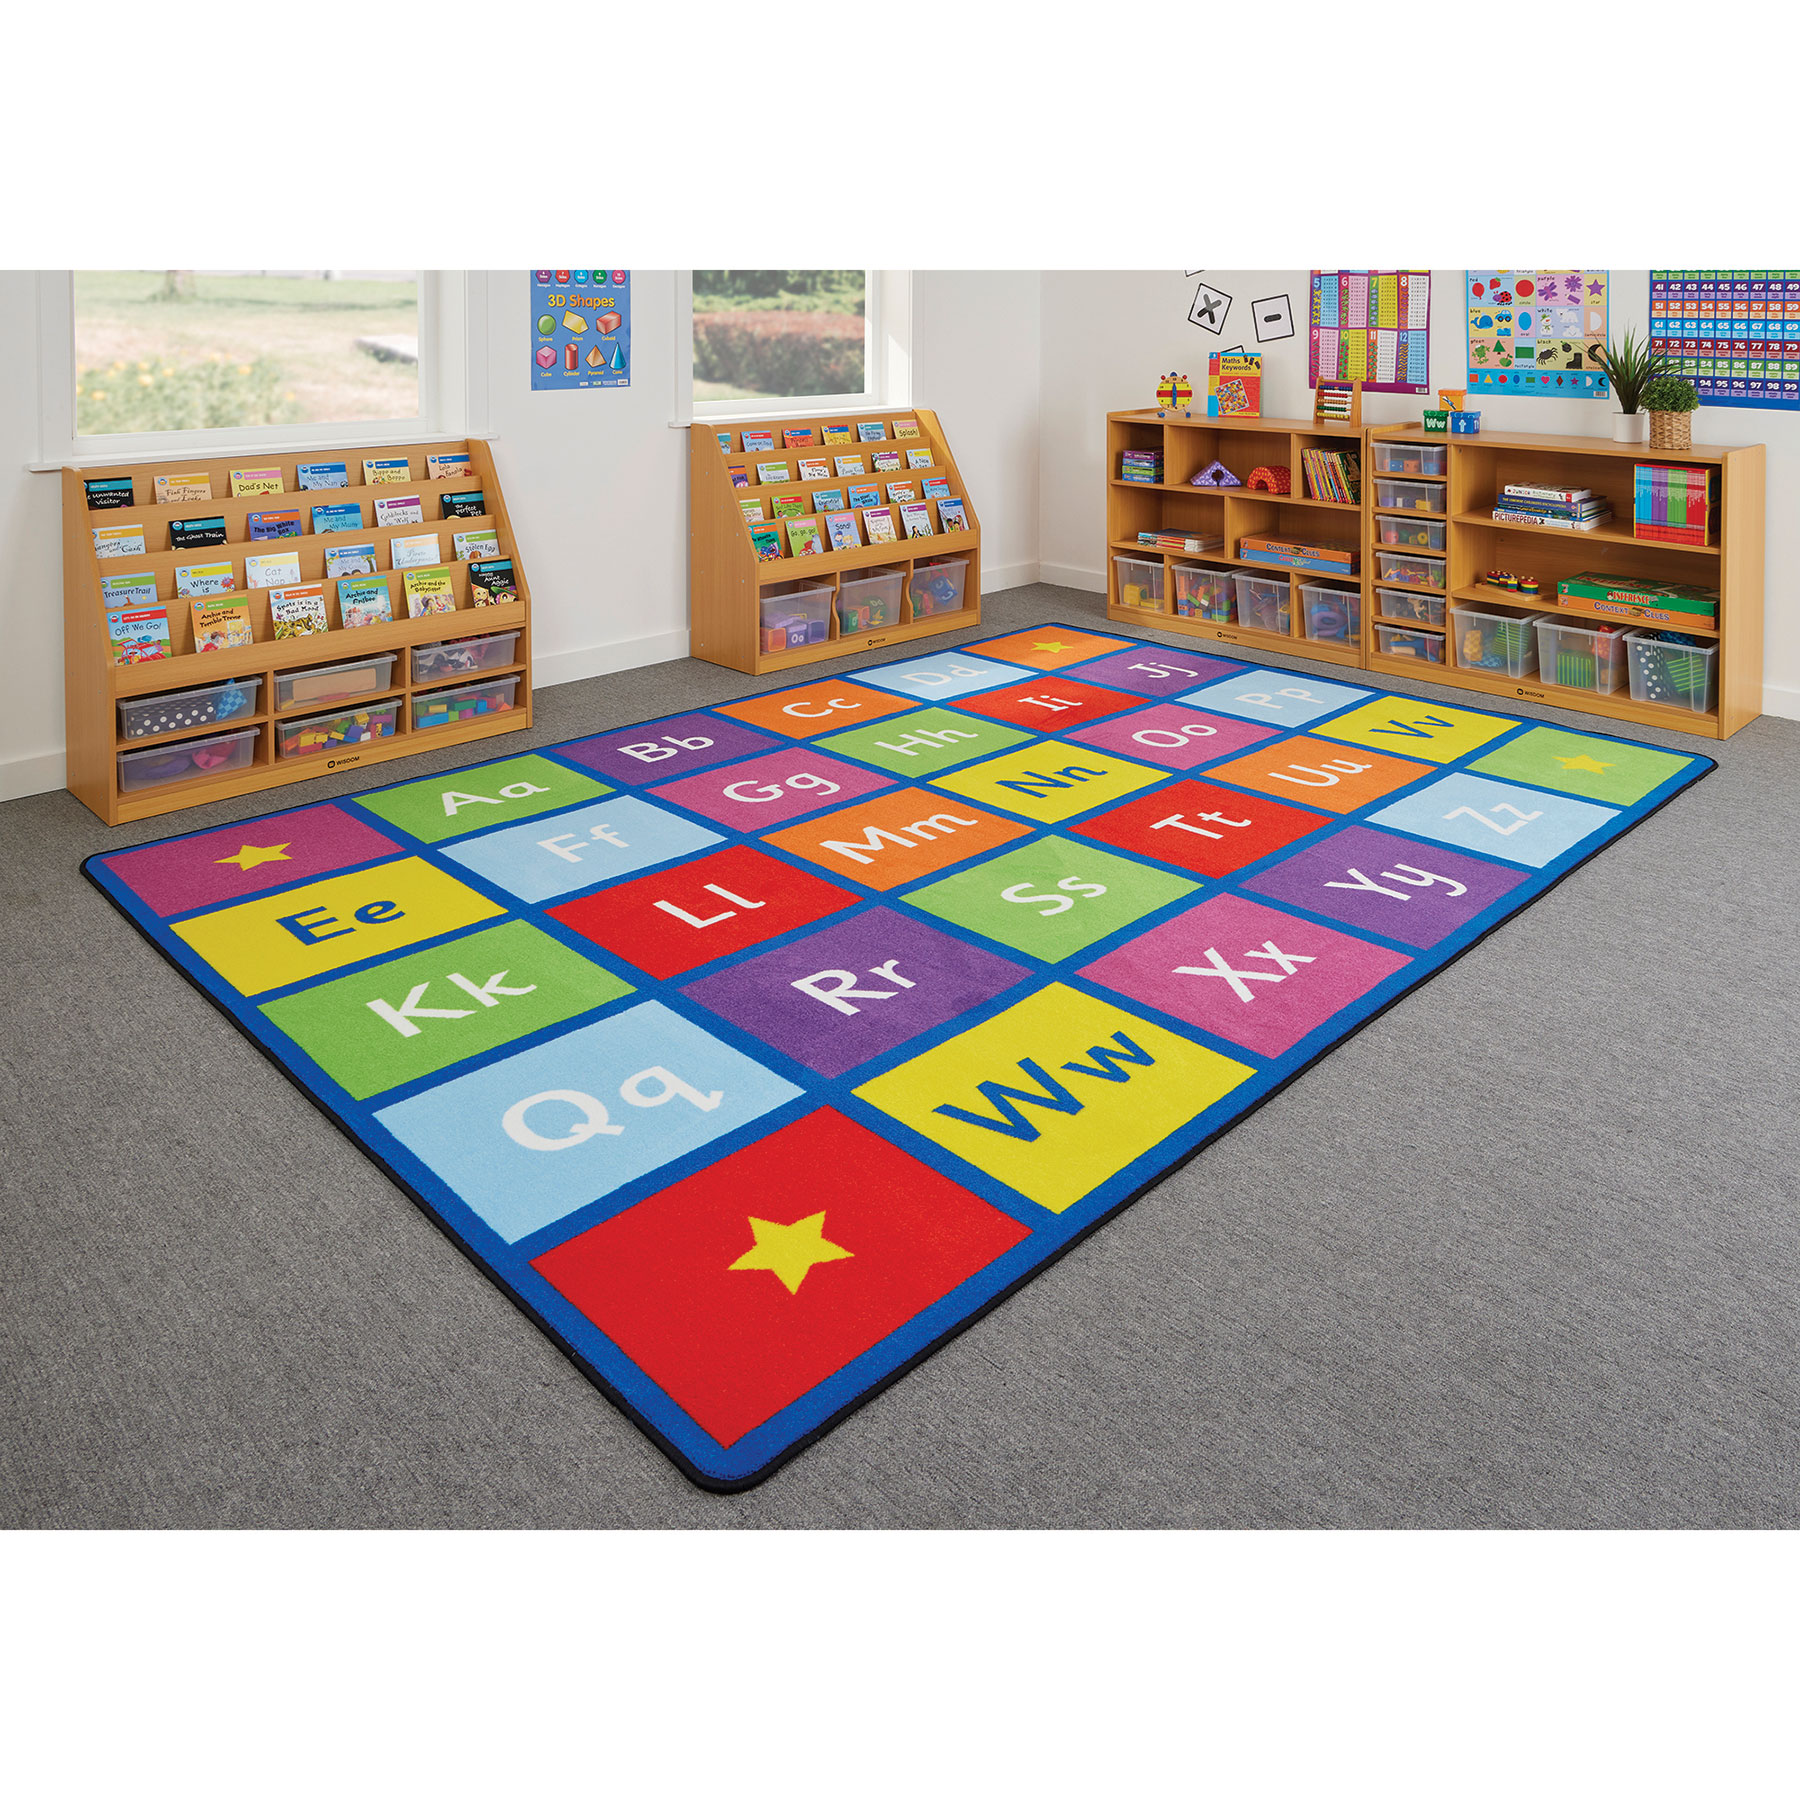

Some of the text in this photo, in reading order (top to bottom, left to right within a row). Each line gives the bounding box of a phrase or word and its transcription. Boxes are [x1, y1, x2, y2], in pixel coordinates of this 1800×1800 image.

[1313, 277, 1320, 288] 5
[1341, 276, 1348, 287] 6
[1371, 277, 1378, 288] 7
[1400, 276, 1408, 287] 8
[1655, 283, 1664, 291] 41
[1669, 283, 1681, 291] 42
[1685, 283, 1697, 291] 43
[1701, 283, 1714, 291] 44
[1718, 283, 1730, 291] 45
[1734, 283, 1748, 291] 46
[1752, 283, 1764, 291] 47
[1769, 283, 1782, 291] 48
[1786, 283, 1800, 291] 49
[548, 294, 615, 311] 3D Shapes
[1655, 302, 1664, 310] 51
[1669, 302, 1681, 310] 52
[1685, 302, 1697, 310] 53
[1701, 302, 1713, 310] 54
[1769, 303, 1781, 311] 58
[1786, 303, 1799, 311] 59
[1734, 322, 1746, 330] 66
[1312, 329, 1319, 340] 9
[1370, 330, 1377, 340] 11
[1400, 331, 1408, 342] 12
[1701, 341, 1712, 349] 74
[1751, 342, 1762, 350] 77
[1786, 343, 1797, 351] 79
[1733, 361, 1746, 369] 86
[1767, 362, 1780, 370] 88
[1716, 380, 1728, 388] 95
[1425, 418, 1445, 428] Ww
[899, 428, 918, 437] Splash!
[238, 482, 278, 491] Dad's Net
[92, 491, 130, 499] Unwanted
[95, 497, 120, 505] Visitor
[1494, 512, 1538, 525] PICTUREPEDIA
[276, 521, 295, 530] White
[205, 531, 224, 539] Train
[265, 567, 282, 577] Cat
[190, 579, 219, 588] Where
[104, 587, 151, 598] Treasure Trail
[345, 590, 366, 599] Archie
[1612, 591, 1650, 605] INFERENCE
[276, 600, 296, 611] Spots
[115, 621, 162, 636] Off We Go!
[791, 633, 804, 643] Oo
[900, 664, 989, 686] Dd
[1126, 662, 1199, 679] Jj
[1233, 687, 1325, 709] Pp
[1524, 690, 1545, 698] WISDOM
[782, 698, 862, 718] Cc
[1017, 697, 1083, 712] Ii
[1369, 715, 1456, 739] Vv
[1132, 723, 1218, 748] Oo
[874, 728, 980, 756] Hh
[617, 735, 715, 764] Bb
[336, 756, 360, 765] WISDOM
[1268, 759, 1372, 787] Uu
[723, 772, 842, 803] Gg
[996, 766, 1108, 798] Nn
[442, 782, 551, 817] Aa
[1441, 802, 1545, 836] Zz
[1150, 811, 1252, 840] Tt
[536, 823, 630, 863] Ff
[820, 814, 978, 865] Mm
[1323, 863, 1468, 902] Yy
[1000, 875, 1108, 917] Ss
[653, 883, 766, 929] Ll
[275, 901, 405, 946] Ee
[1172, 940, 1317, 1004] Xx
[790, 958, 917, 1017] Rr
[366, 970, 537, 1038] Kk
[933, 1031, 1156, 1143] Ww
[501, 1065, 724, 1151] Qq
